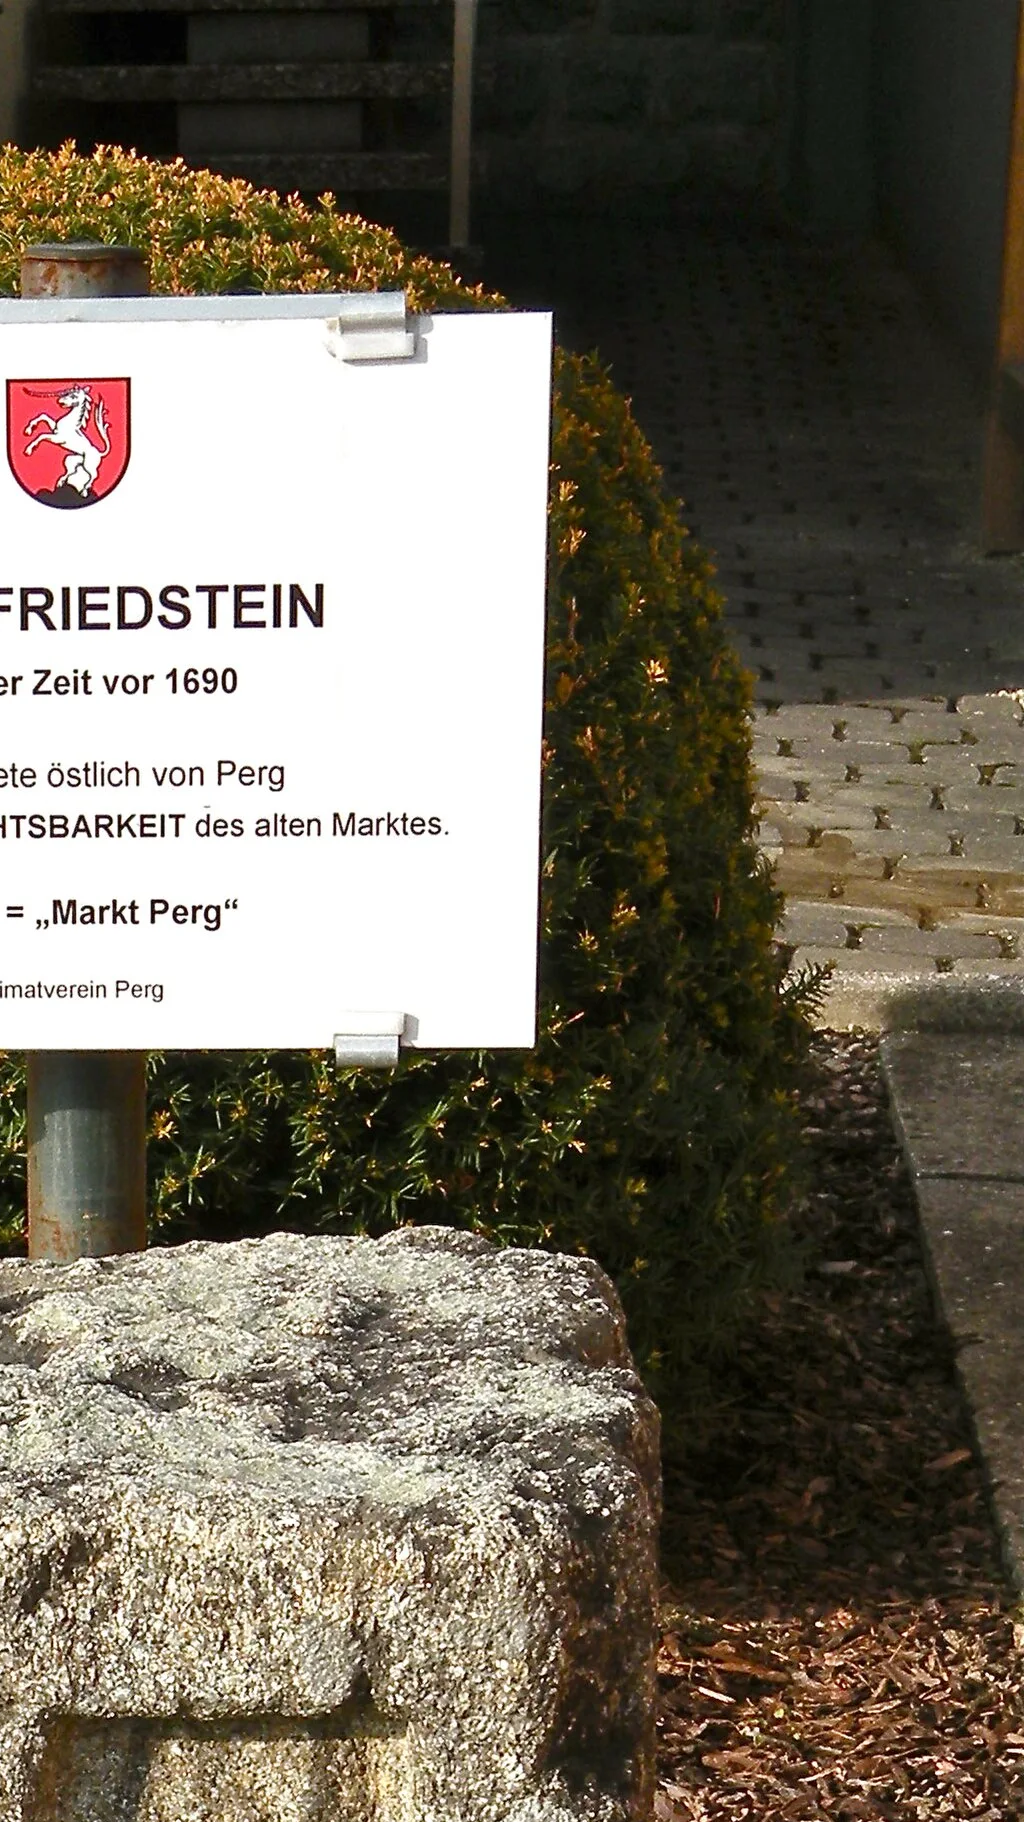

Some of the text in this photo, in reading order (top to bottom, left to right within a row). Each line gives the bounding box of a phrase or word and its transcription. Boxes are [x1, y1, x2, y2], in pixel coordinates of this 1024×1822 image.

[33, 668, 93, 696] Zeit
[103, 674, 155, 695] vor
[165, 667, 238, 695] 1690
[47, 760, 140, 788] östlich
[151, 766, 205, 787] von
[217, 760, 285, 792] Perg
[195, 813, 245, 838] des
[254, 812, 322, 837] alten
[332, 811, 449, 837] Marktes.
[115, 979, 164, 1003] Perg
